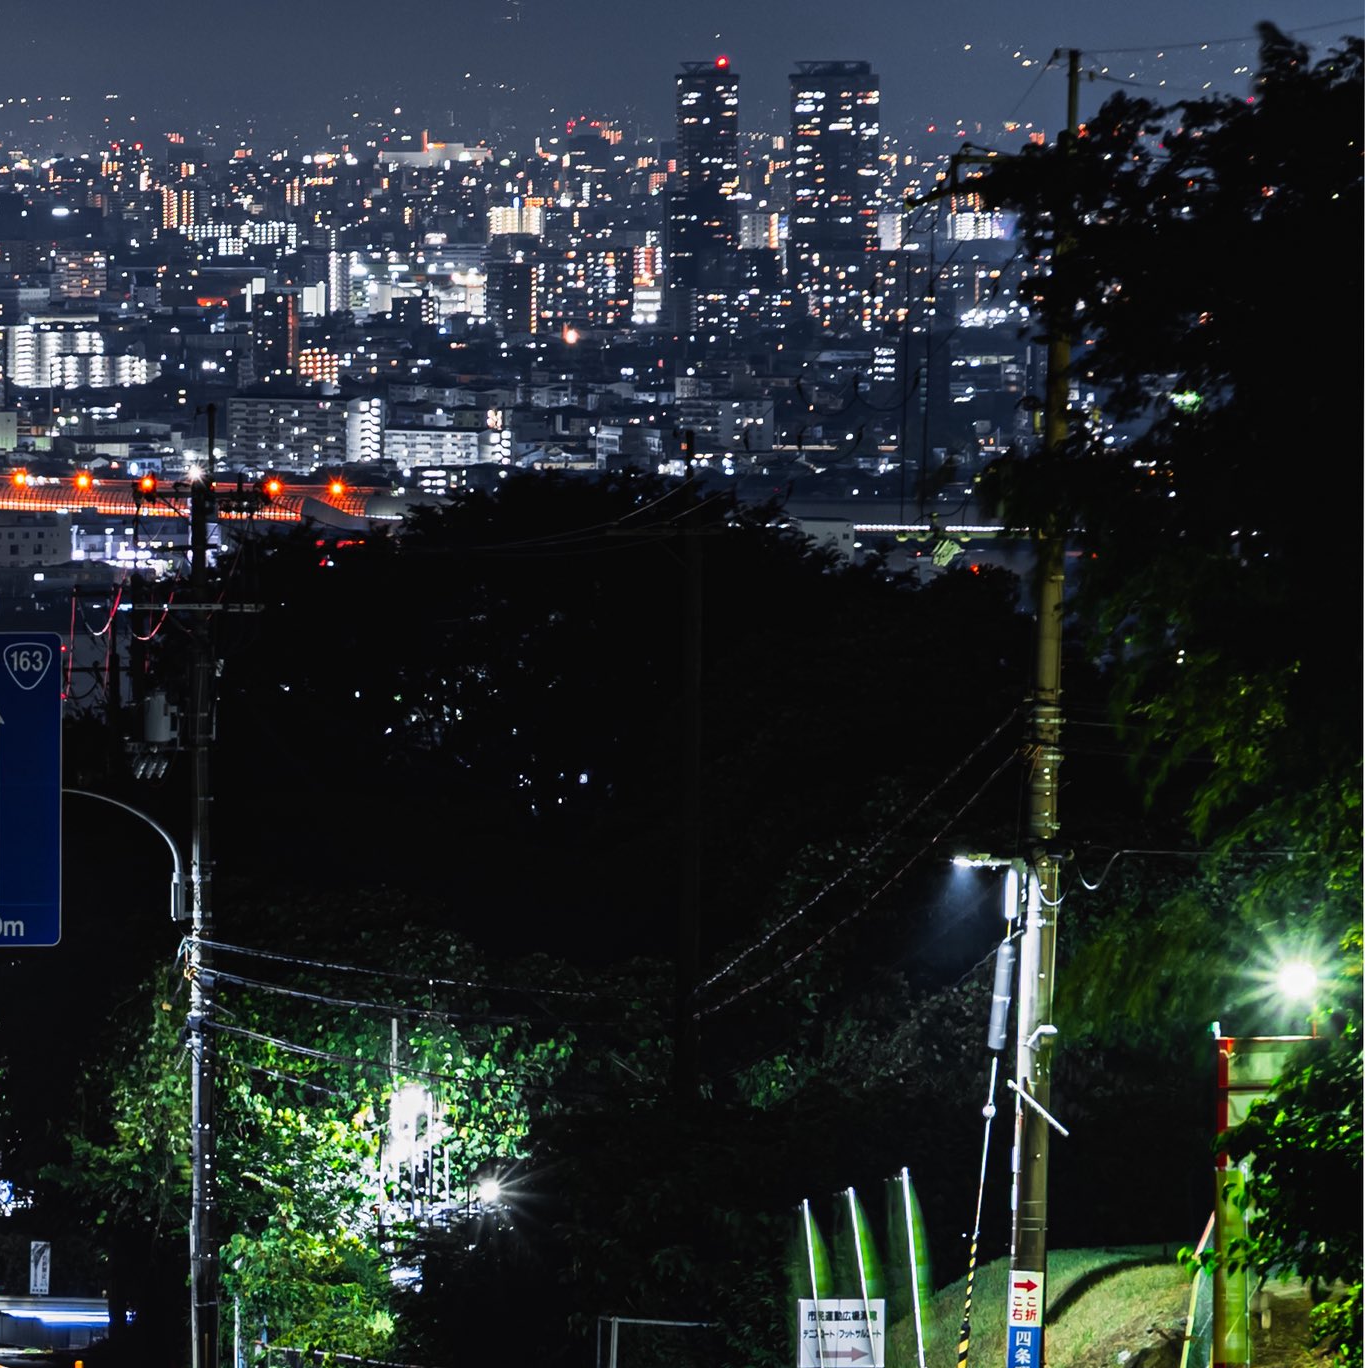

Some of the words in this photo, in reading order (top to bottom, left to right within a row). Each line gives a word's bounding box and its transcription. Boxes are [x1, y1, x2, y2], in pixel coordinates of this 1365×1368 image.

[10, 651, 43, 672] 163
[1013, 1296, 1036, 1307] ここ
[1012, 1309, 1037, 1321] 右折
